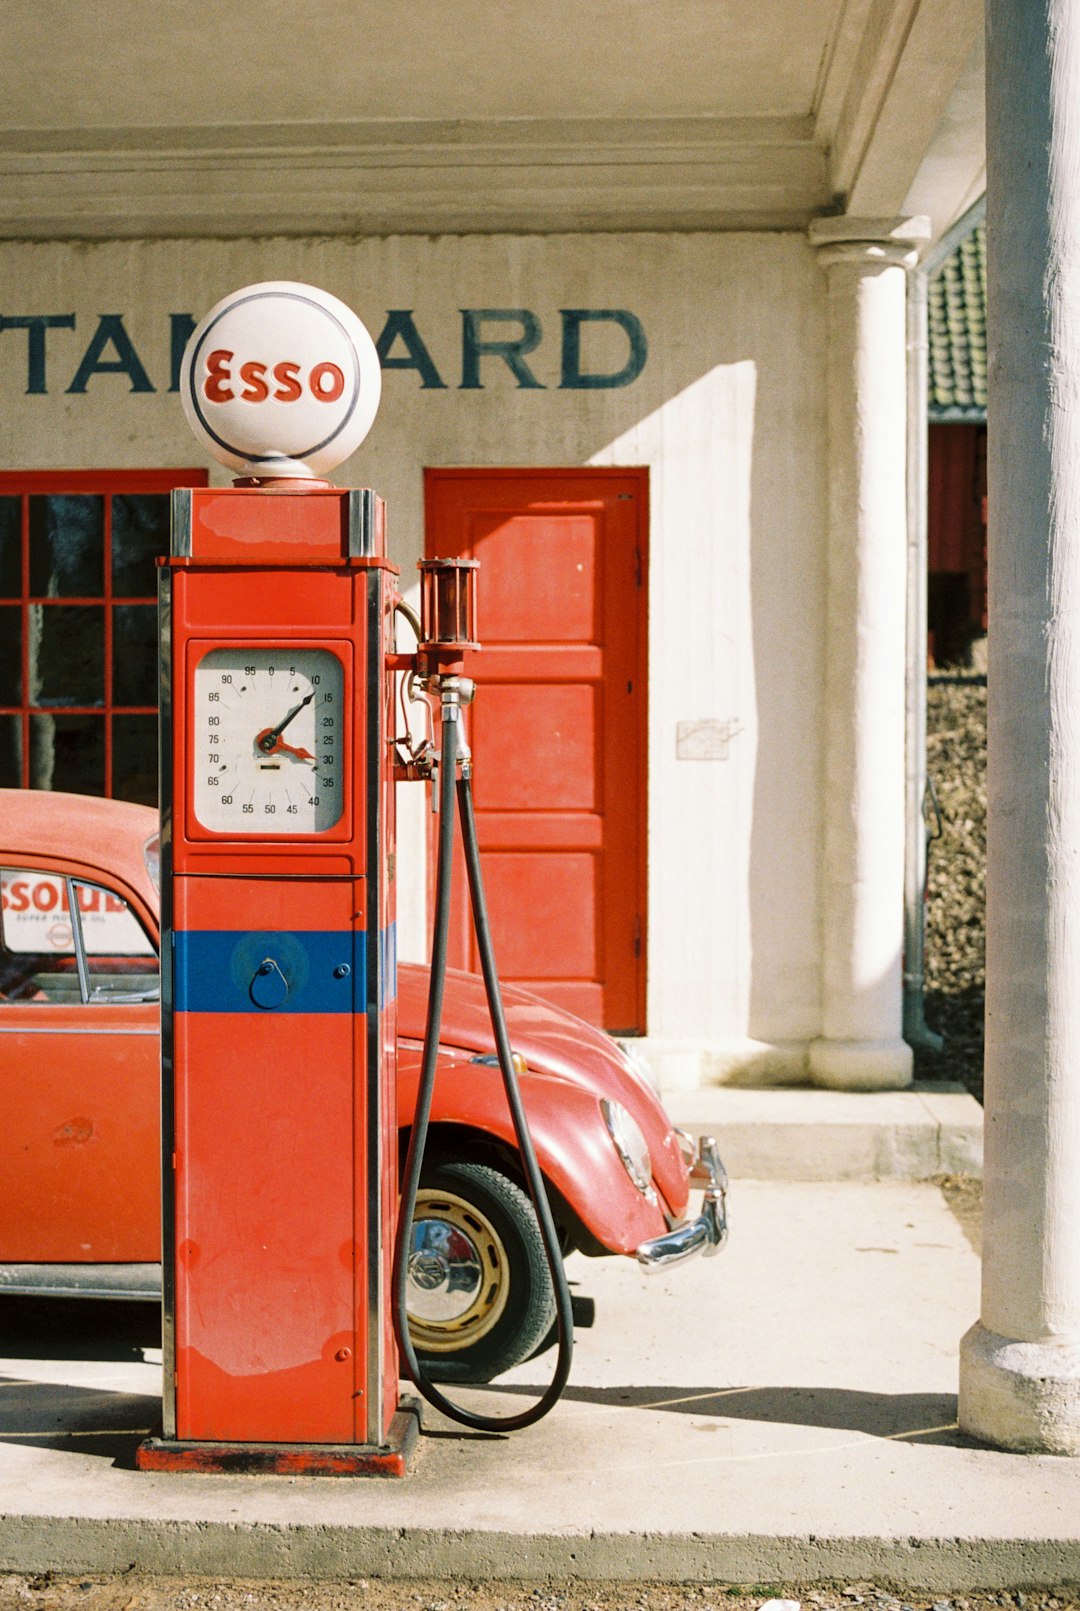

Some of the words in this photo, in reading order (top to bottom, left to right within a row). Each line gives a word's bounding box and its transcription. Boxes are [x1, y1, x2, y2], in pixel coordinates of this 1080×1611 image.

[0, 309, 648, 394] TAARD
[244, 667, 256, 676] 95
[268, 667, 275, 676] 0
[289, 667, 296, 676] 5
[221, 675, 232, 684] 90
[311, 675, 320, 685] 10
[208, 693, 220, 702] 85
[324, 693, 333, 702] 15
[208, 717, 220, 726] 80
[323, 718, 334, 727] 20
[209, 735, 219, 744] 75
[323, 736, 334, 745] 25
[208, 754, 219, 763] 70
[323, 755, 334, 764] 30
[208, 777, 219, 786] 65
[323, 778, 334, 787] 35
[221, 795, 233, 805] 60
[308, 797, 320, 806] 40
[242, 804, 254, 814] 55
[264, 805, 276, 814] 50
[286, 805, 298, 814] 45
